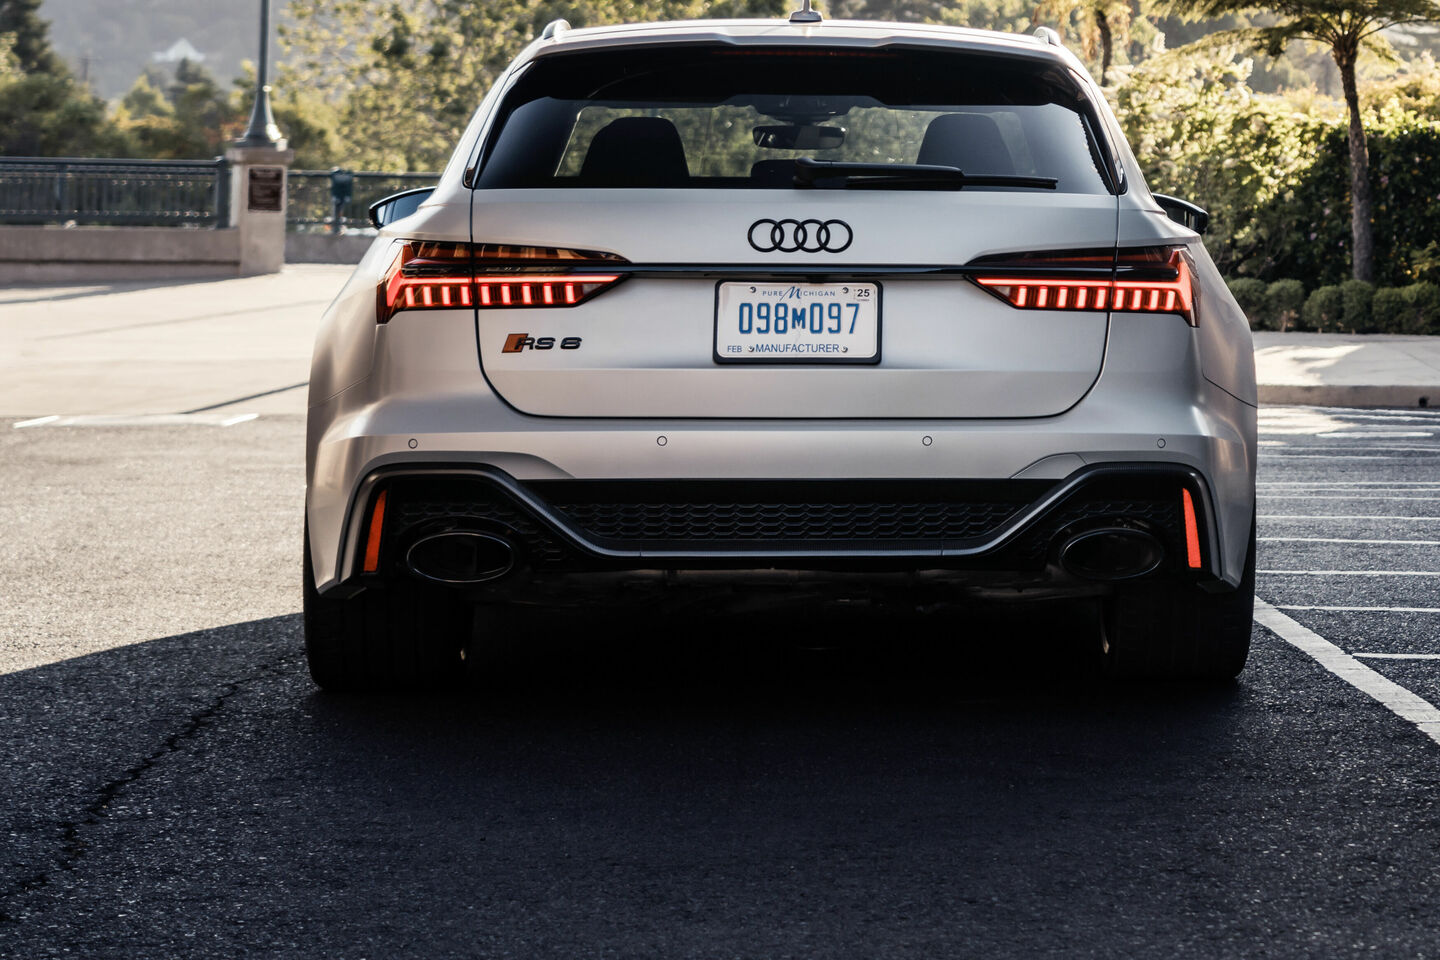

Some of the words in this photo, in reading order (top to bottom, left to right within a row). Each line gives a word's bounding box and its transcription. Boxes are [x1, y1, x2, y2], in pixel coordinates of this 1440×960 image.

[780, 286, 836, 301] MICHIGAN
[857, 288, 870, 298] 25
[738, 302, 860, 335] 098M097
[513, 336, 556, 350] RS
[560, 336, 582, 350] 6
[727, 345, 742, 353] FEB
[755, 343, 840, 353] MANUFACTURER
